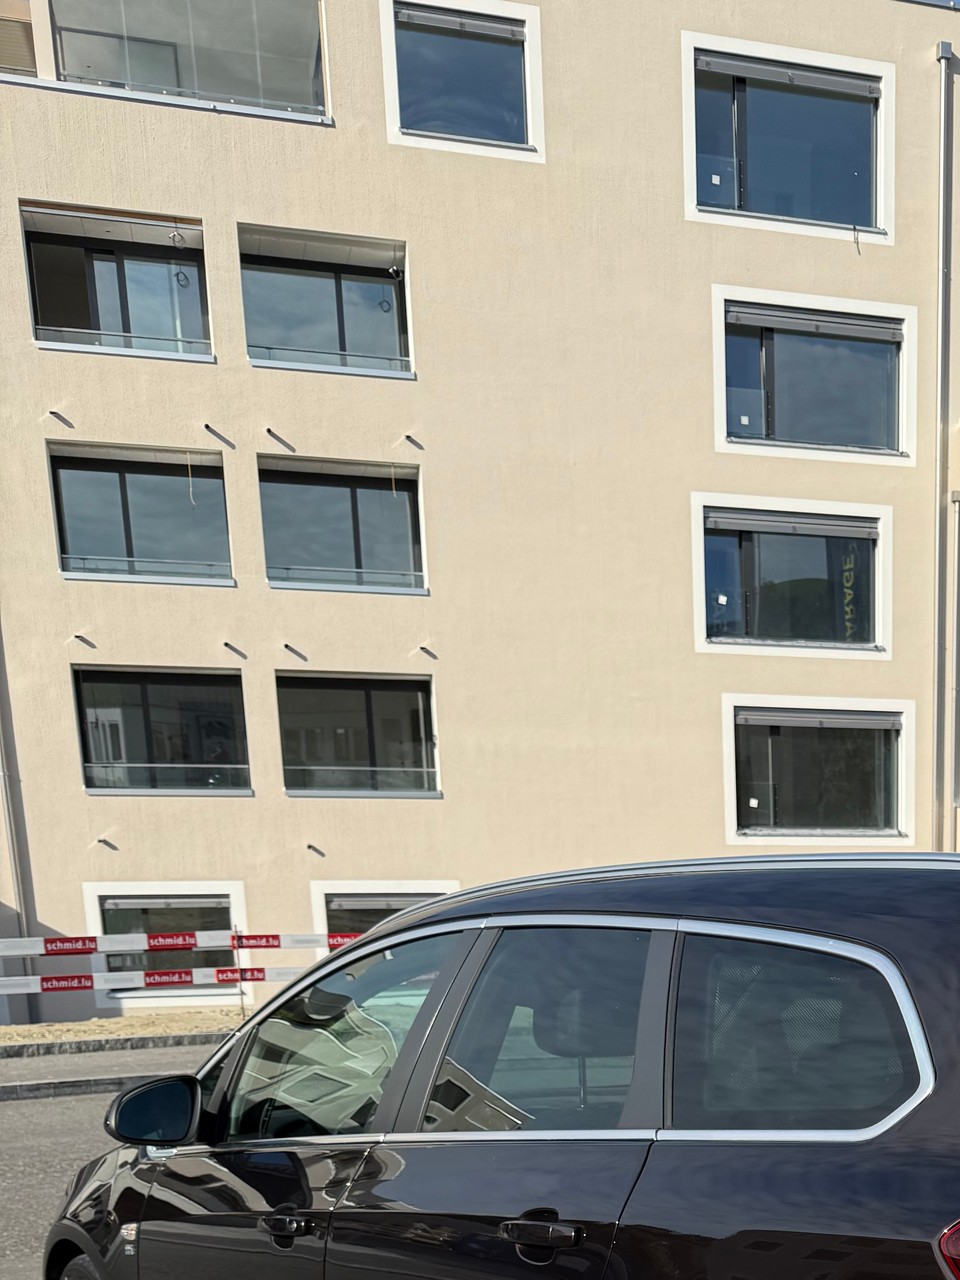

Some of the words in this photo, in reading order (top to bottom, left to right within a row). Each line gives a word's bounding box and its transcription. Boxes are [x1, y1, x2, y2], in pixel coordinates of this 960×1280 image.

[46, 939, 97, 950] schmid.lu
[149, 934, 196, 946] schmid.lu
[42, 977, 93, 989] schmid.lu
[145, 973, 192, 984] schmid.lu
